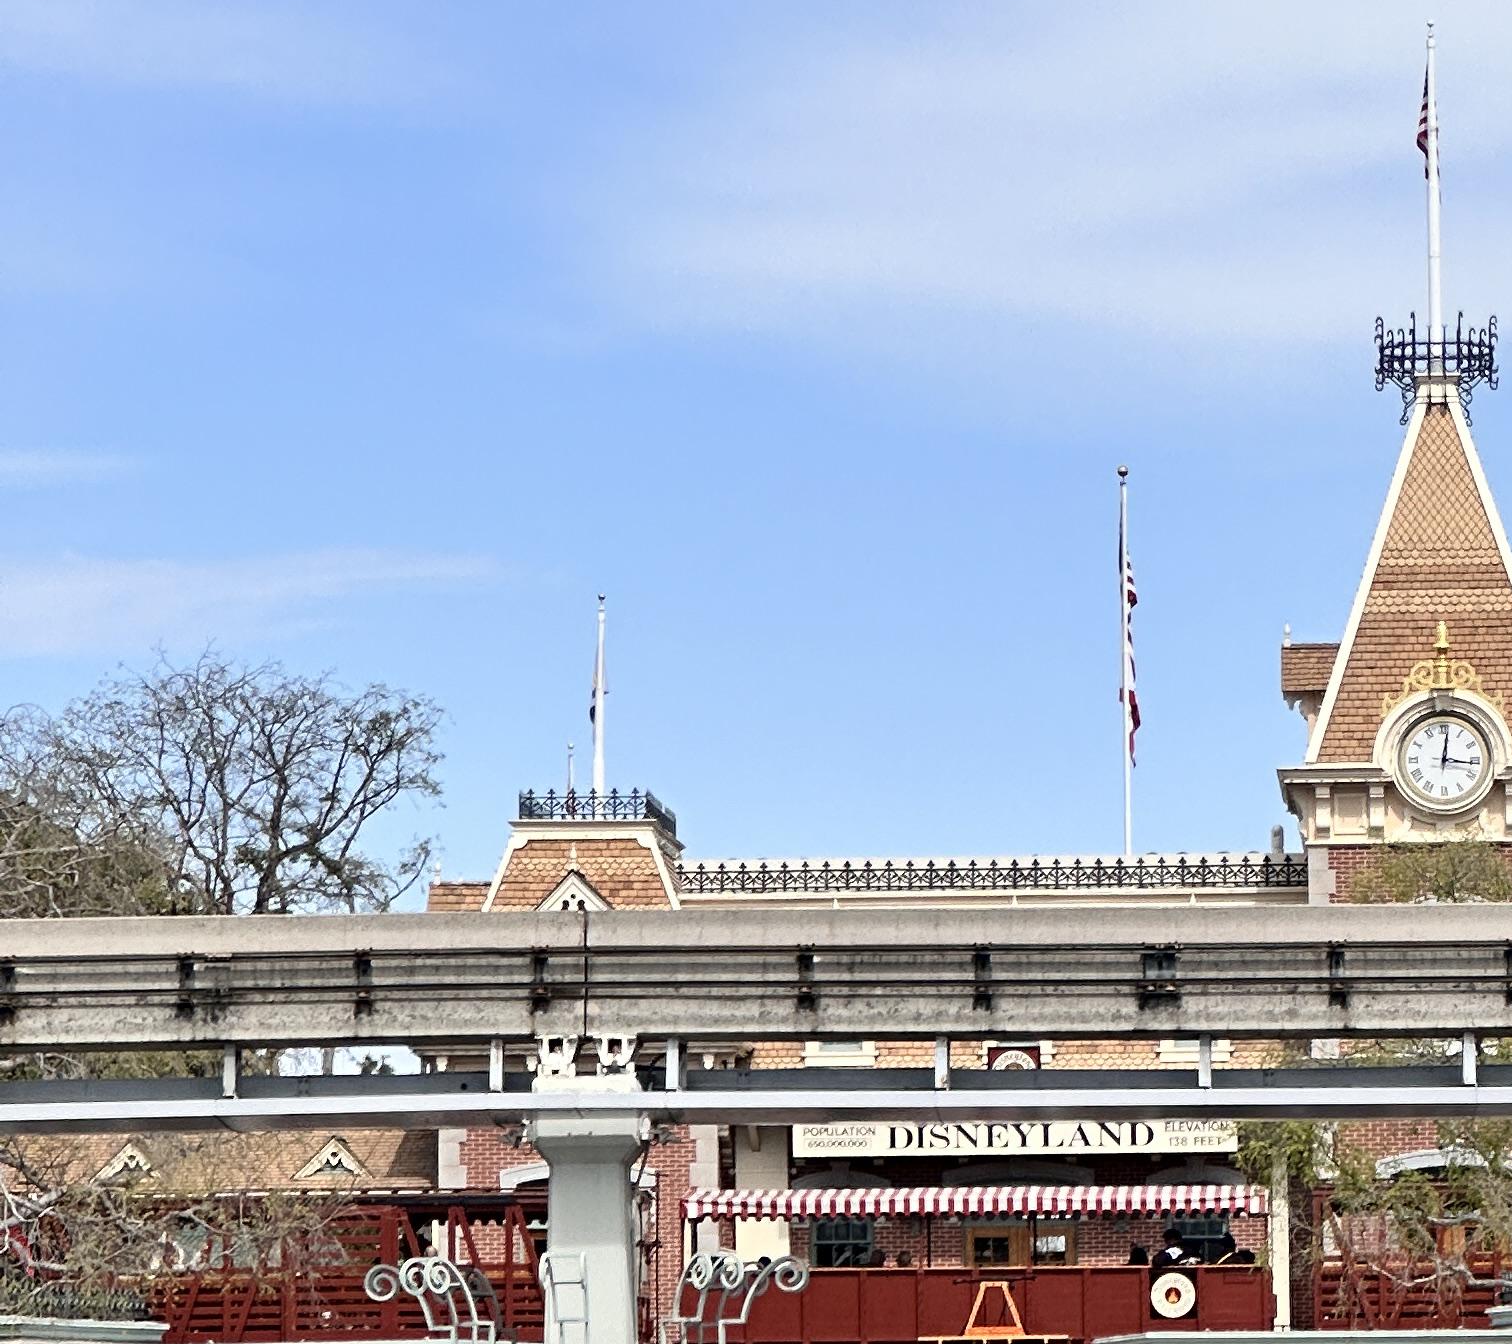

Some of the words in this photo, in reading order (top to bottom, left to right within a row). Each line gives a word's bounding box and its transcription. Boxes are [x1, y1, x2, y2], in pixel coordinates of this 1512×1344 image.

[802, 1125, 876, 1137] POPULATION
[888, 1121, 1155, 1149] DISNEYLAND
[1193, 1135, 1221, 1147] FEET
